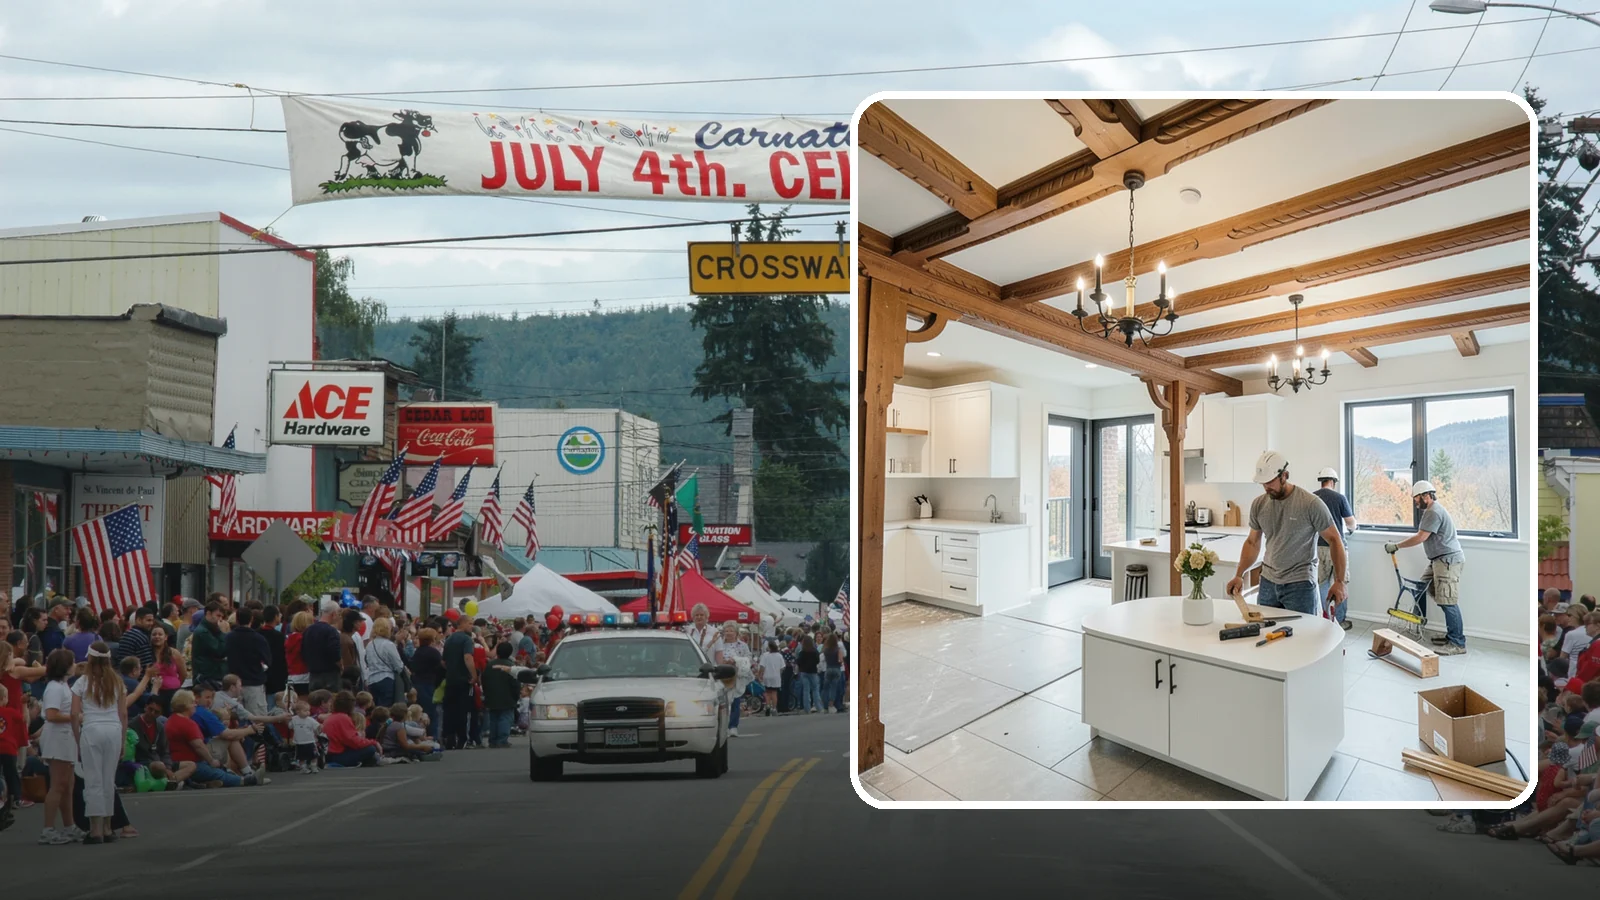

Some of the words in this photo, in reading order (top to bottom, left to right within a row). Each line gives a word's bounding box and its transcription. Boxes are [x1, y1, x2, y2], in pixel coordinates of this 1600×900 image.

[481, 141, 606, 192] JULY
[632, 149, 747, 199] 4th.
[697, 254, 850, 280] CROSSWA
[283, 380, 373, 420] ACE
[405, 409, 452, 421] CEDAR
[461, 409, 485, 421] LOG
[283, 421, 371, 437] Hardware
[353, 467, 384, 479] Simpl
[83, 485, 93, 494] St.
[96, 485, 124, 494] Vincent
[126, 486, 136, 495] de
[137, 486, 155, 495] Paul
[688, 526, 741, 535] CRNATION
[699, 535, 730, 543] GLASS
